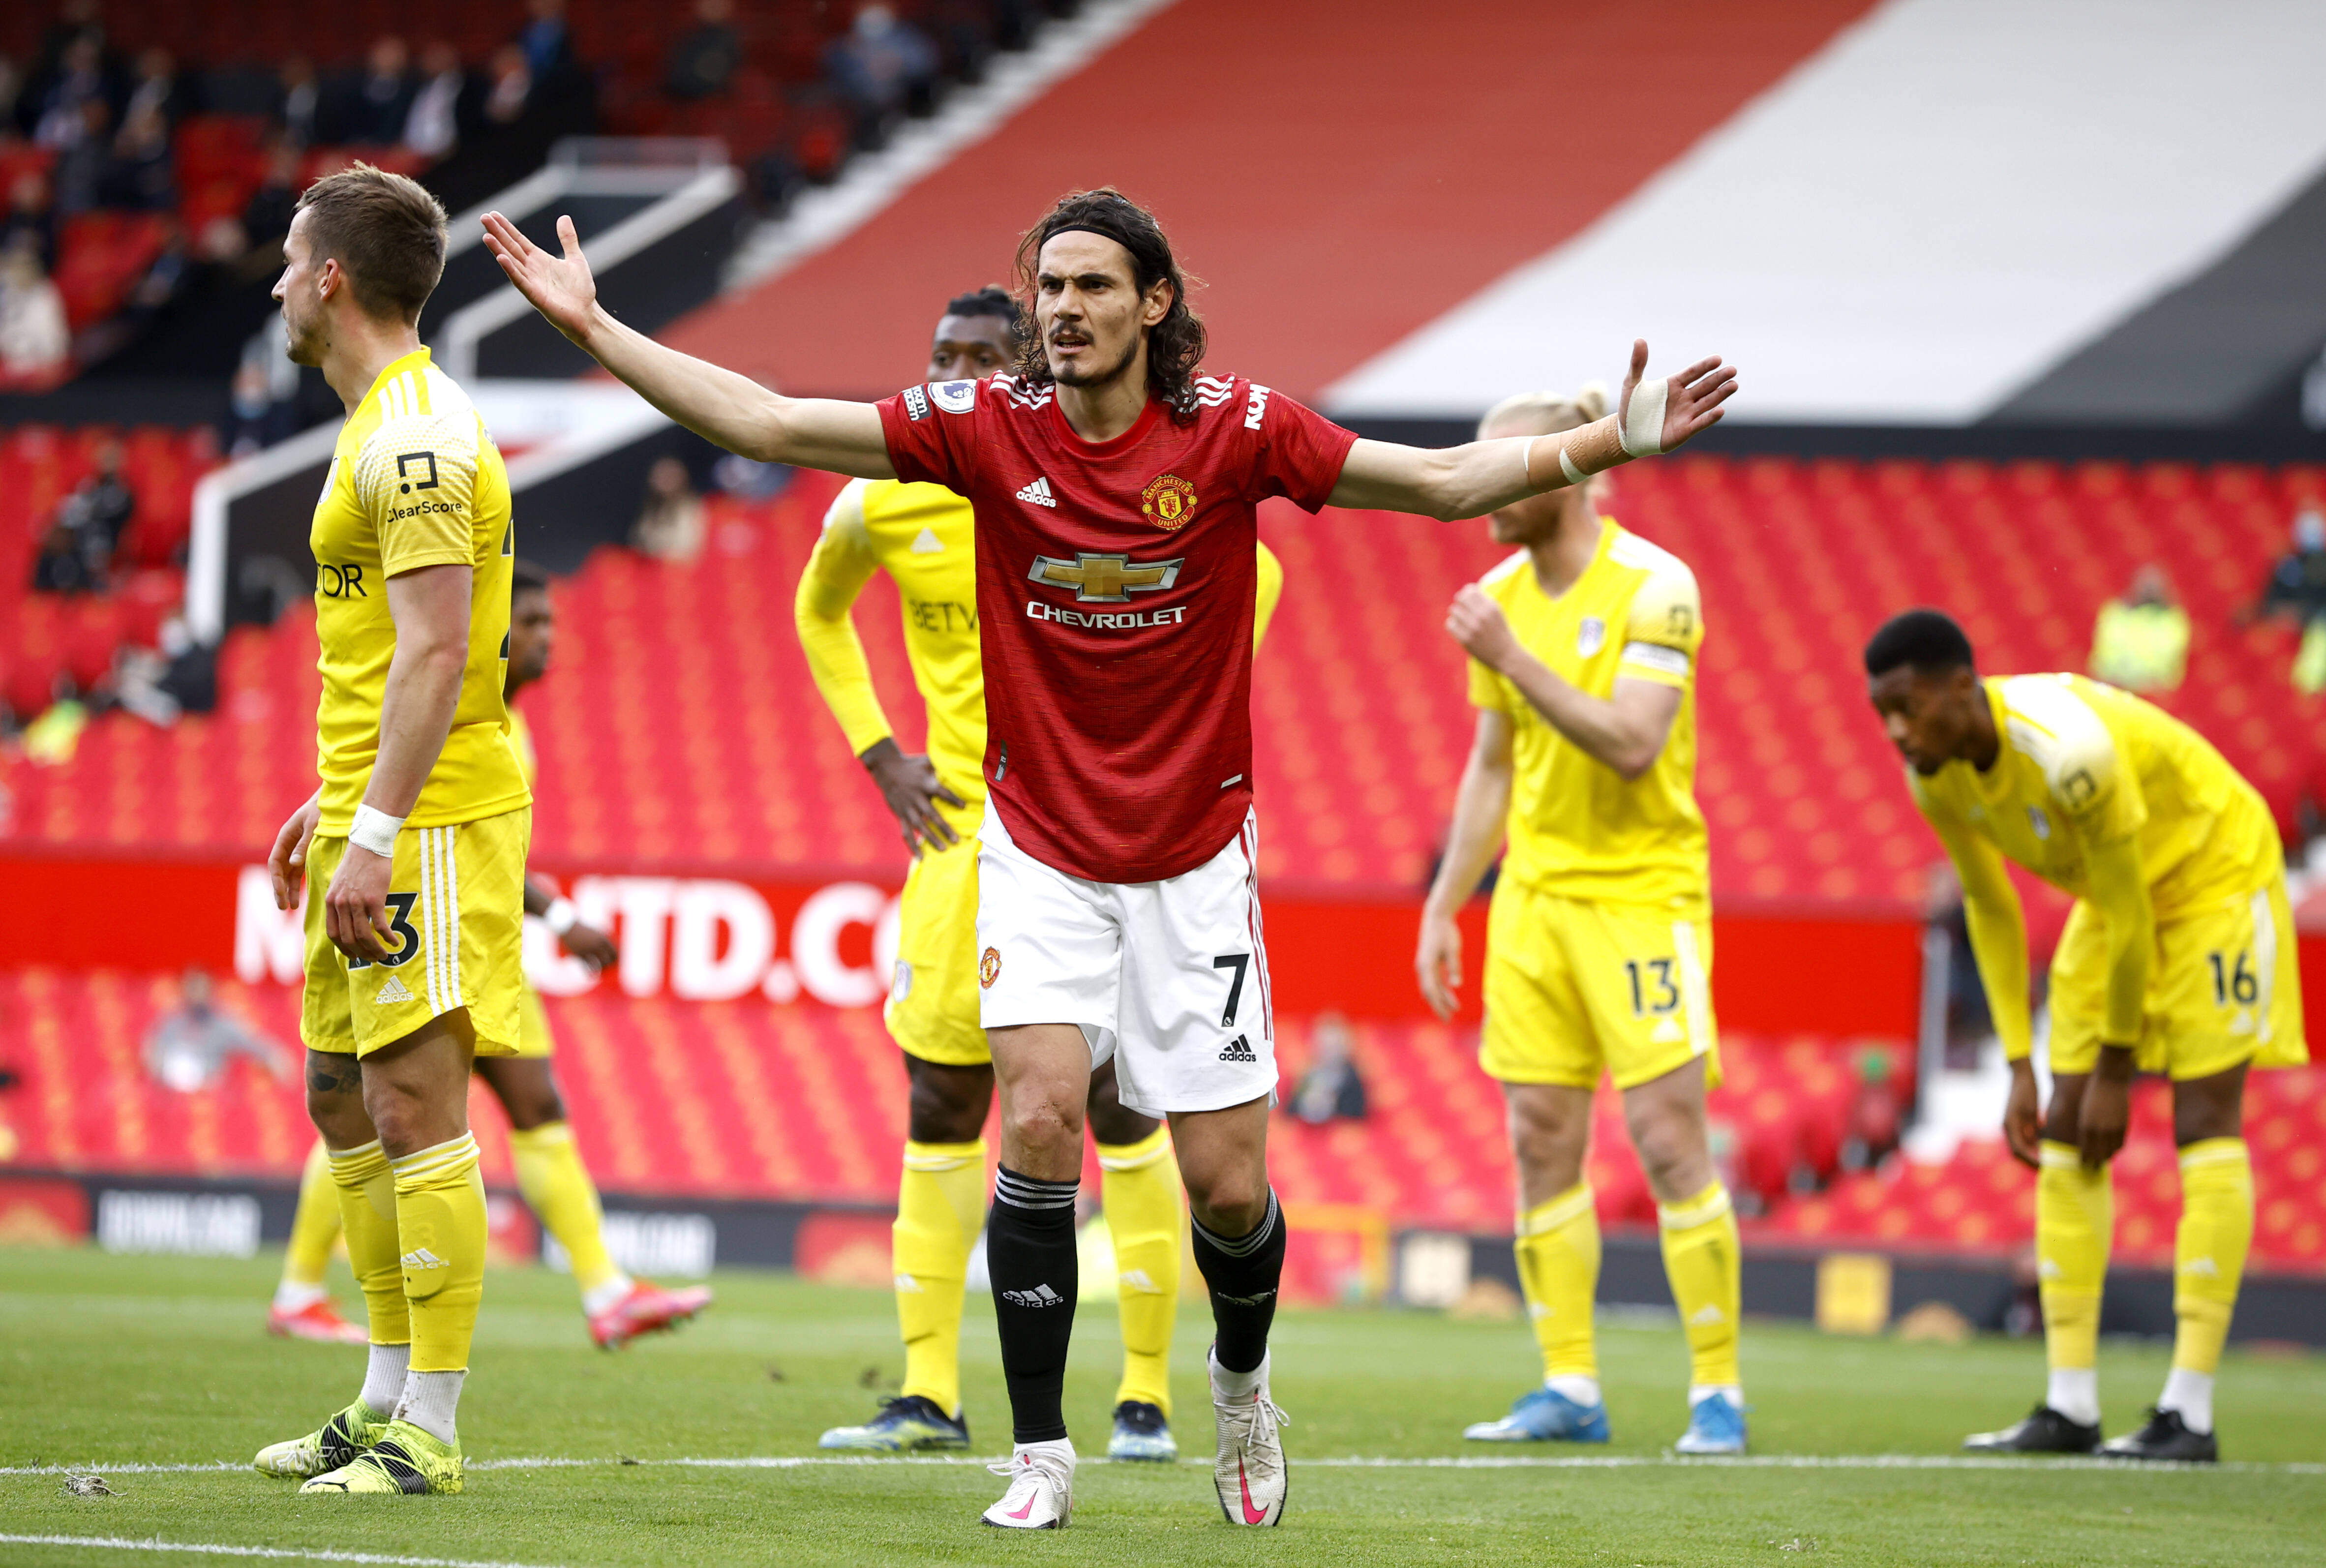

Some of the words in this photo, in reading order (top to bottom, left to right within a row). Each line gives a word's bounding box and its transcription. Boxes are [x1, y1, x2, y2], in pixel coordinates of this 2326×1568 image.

[1016, 491, 1057, 508] adidas
[1146, 478, 1190, 500] MANCHESTER
[1157, 514, 1188, 527] UNITED
[1027, 601, 1187, 629] CHEVROLET
[348, 892, 421, 971] 3
[1625, 956, 1680, 1017] 13
[2206, 948, 2259, 1006] 16
[376, 992, 414, 1004] adidas
[1213, 953, 1250, 1027] 7
[1219, 1051, 1257, 1062] adidas
[1002, 1291, 1064, 1308] adidas
